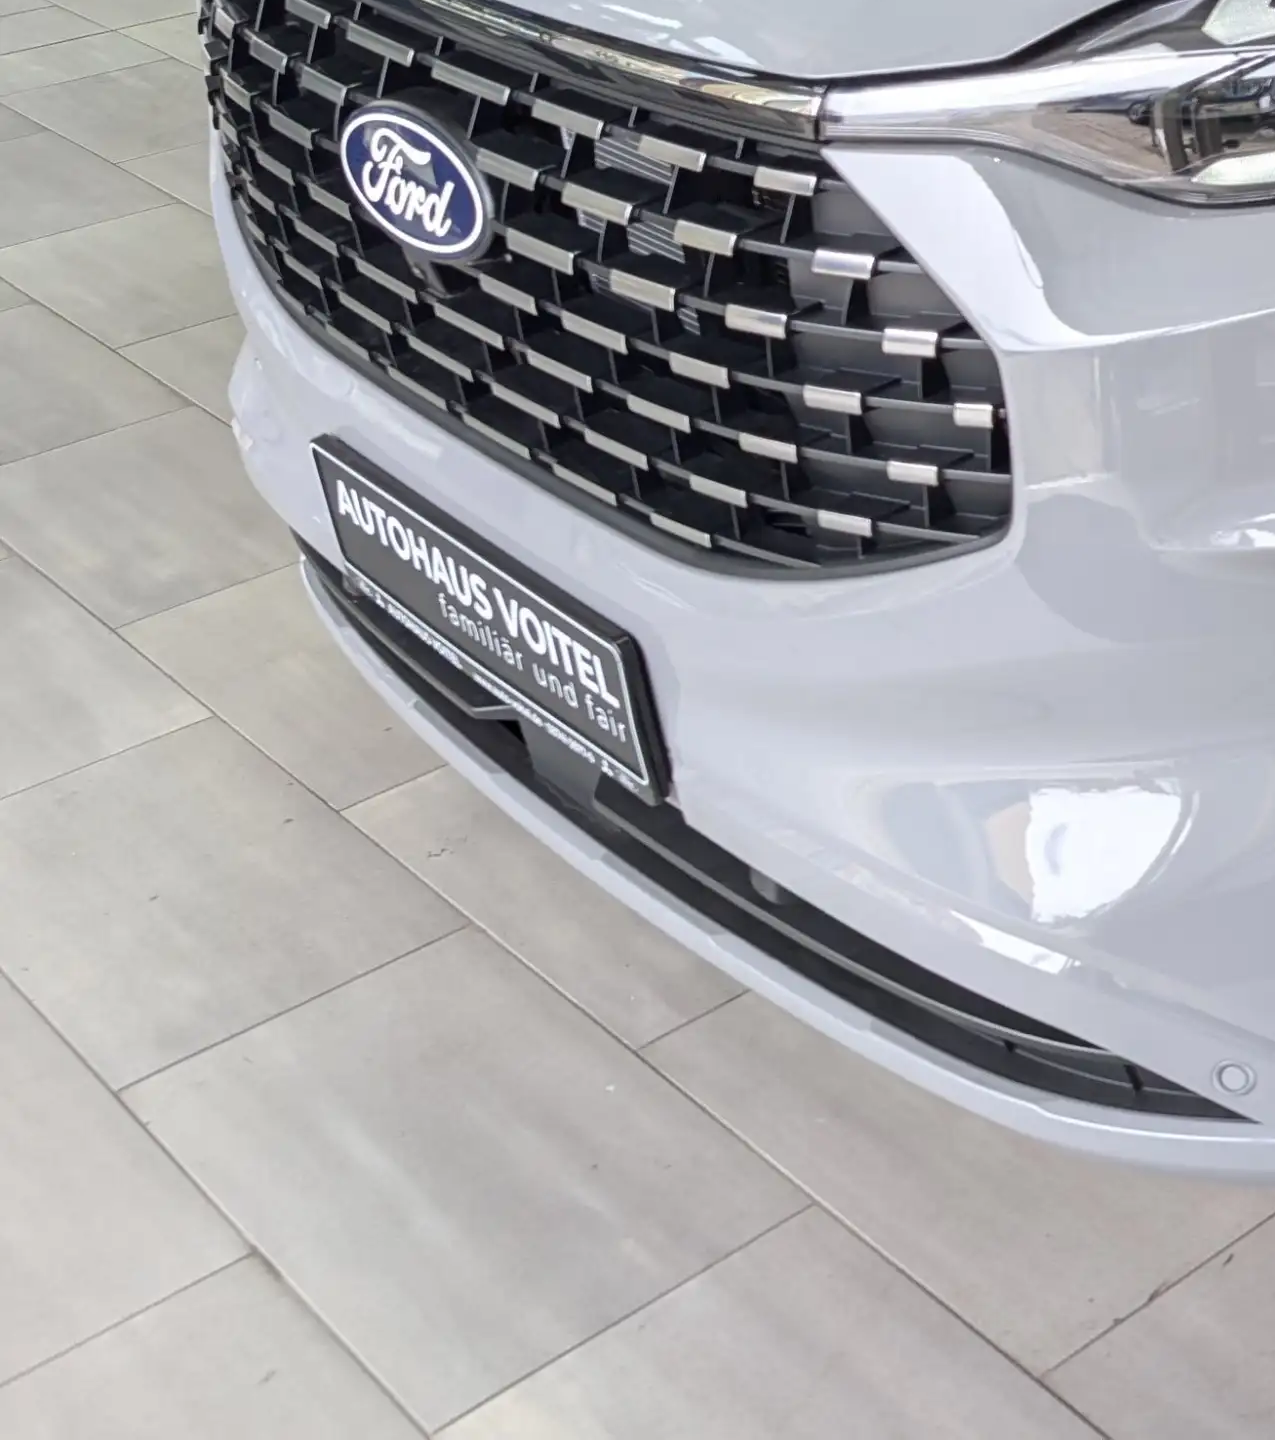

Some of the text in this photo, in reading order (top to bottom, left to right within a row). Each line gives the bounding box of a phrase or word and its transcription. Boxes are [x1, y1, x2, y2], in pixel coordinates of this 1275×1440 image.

[362, 127, 455, 238] Ford
[336, 479, 493, 620] AUTOHAUS
[492, 586, 620, 709] VOITEL
[437, 592, 524, 671] familiär
[532, 662, 579, 709] und
[584, 692, 626, 742] fair
